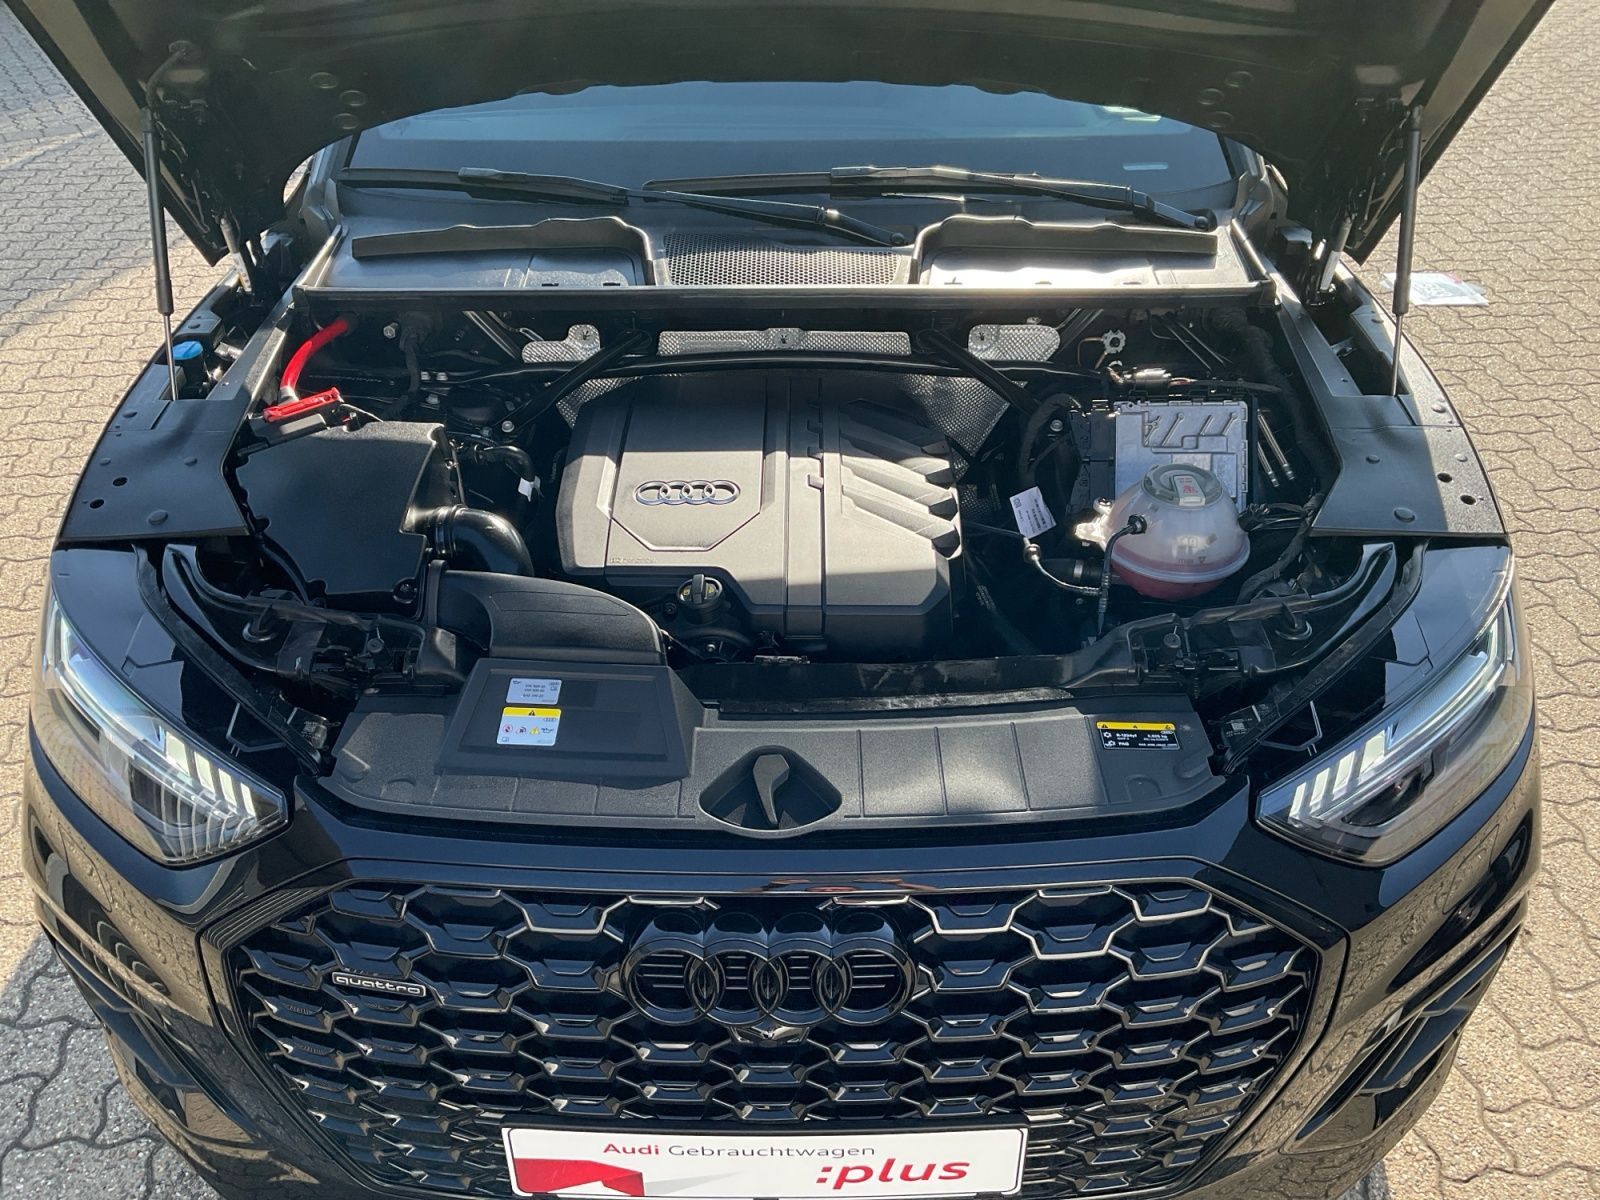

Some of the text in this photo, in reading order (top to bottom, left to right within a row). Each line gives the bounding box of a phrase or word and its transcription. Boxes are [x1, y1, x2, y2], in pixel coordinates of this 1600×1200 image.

[336, 976, 420, 994] quattro
[603, 1143, 875, 1159] Audi Gebrauchtwagen
